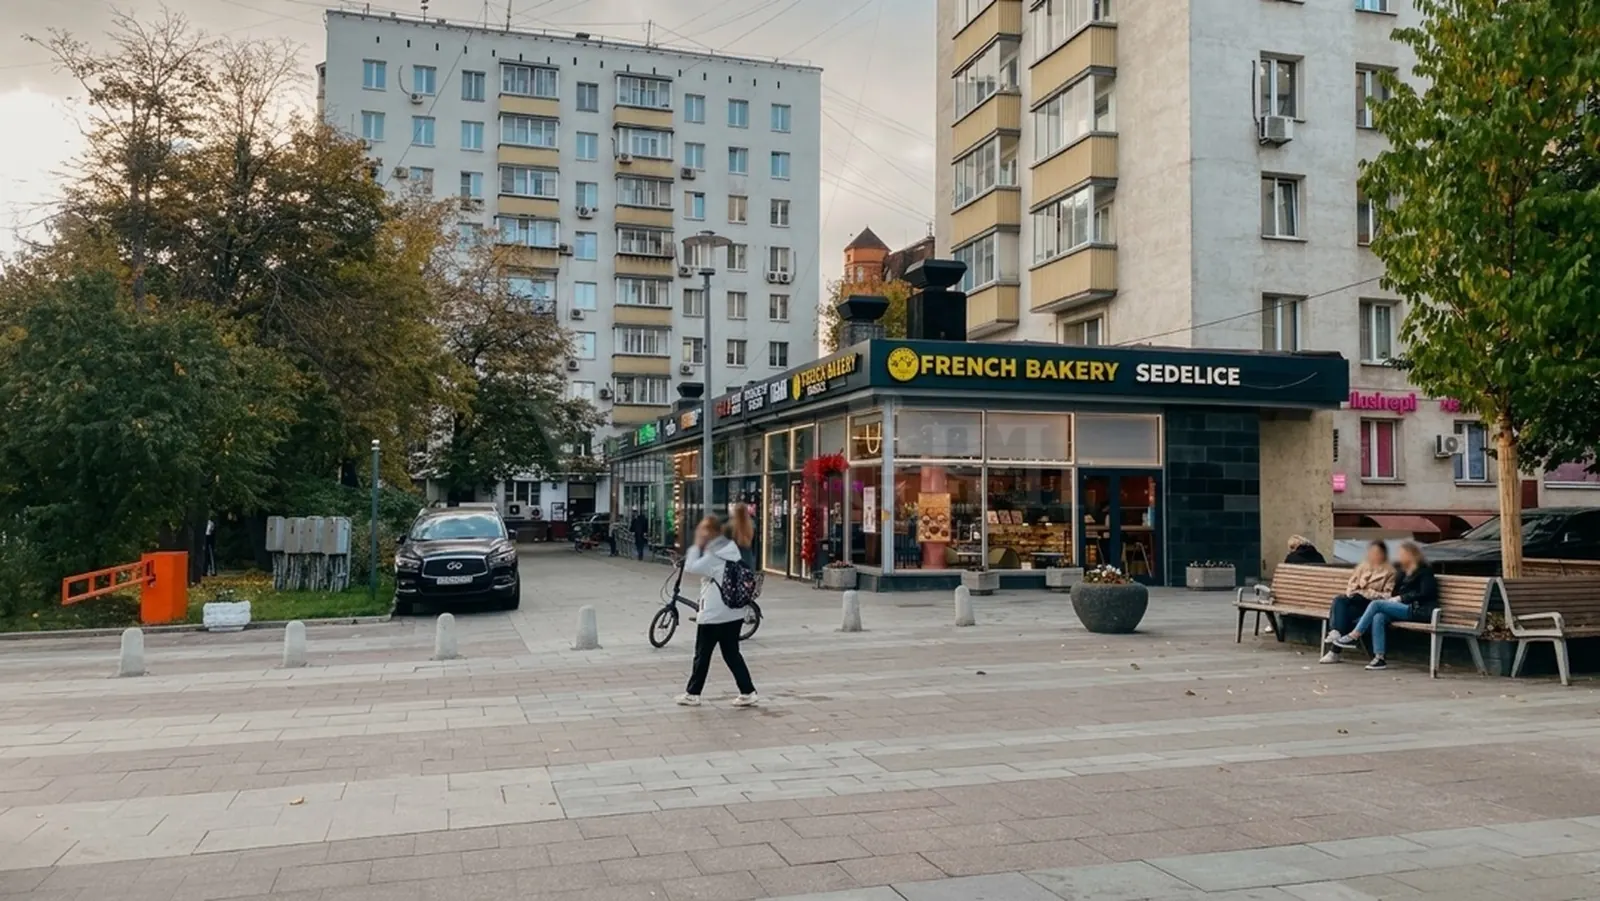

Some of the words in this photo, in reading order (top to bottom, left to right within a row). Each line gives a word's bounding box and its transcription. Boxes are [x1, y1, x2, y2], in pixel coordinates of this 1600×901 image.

[921, 355, 1017, 378] FRENCH
[1026, 358, 1120, 381] BAKERY
[1136, 363, 1241, 386] SEDELICE
